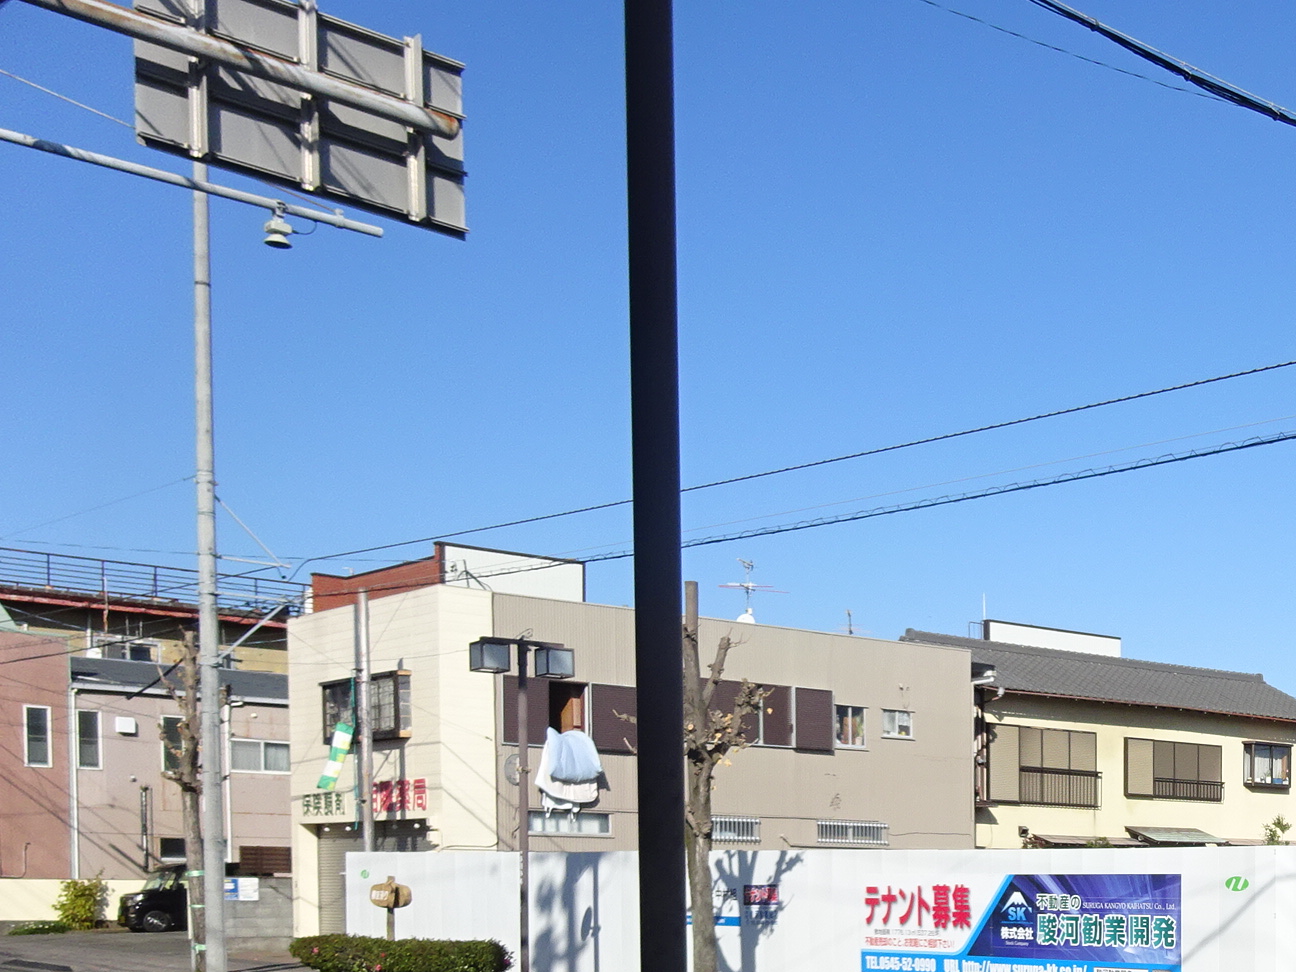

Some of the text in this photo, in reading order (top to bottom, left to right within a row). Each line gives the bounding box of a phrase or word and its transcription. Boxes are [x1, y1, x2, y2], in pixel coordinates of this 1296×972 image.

[865, 884, 971, 929] テナント募集
[1036, 893, 1081, 911] 不動産の
[1008, 906, 1026, 921] SK
[1001, 926, 1034, 940] 株式会社
[1036, 913, 1177, 949] 駿河勧業開発
[944, 958, 959, 972] URL
